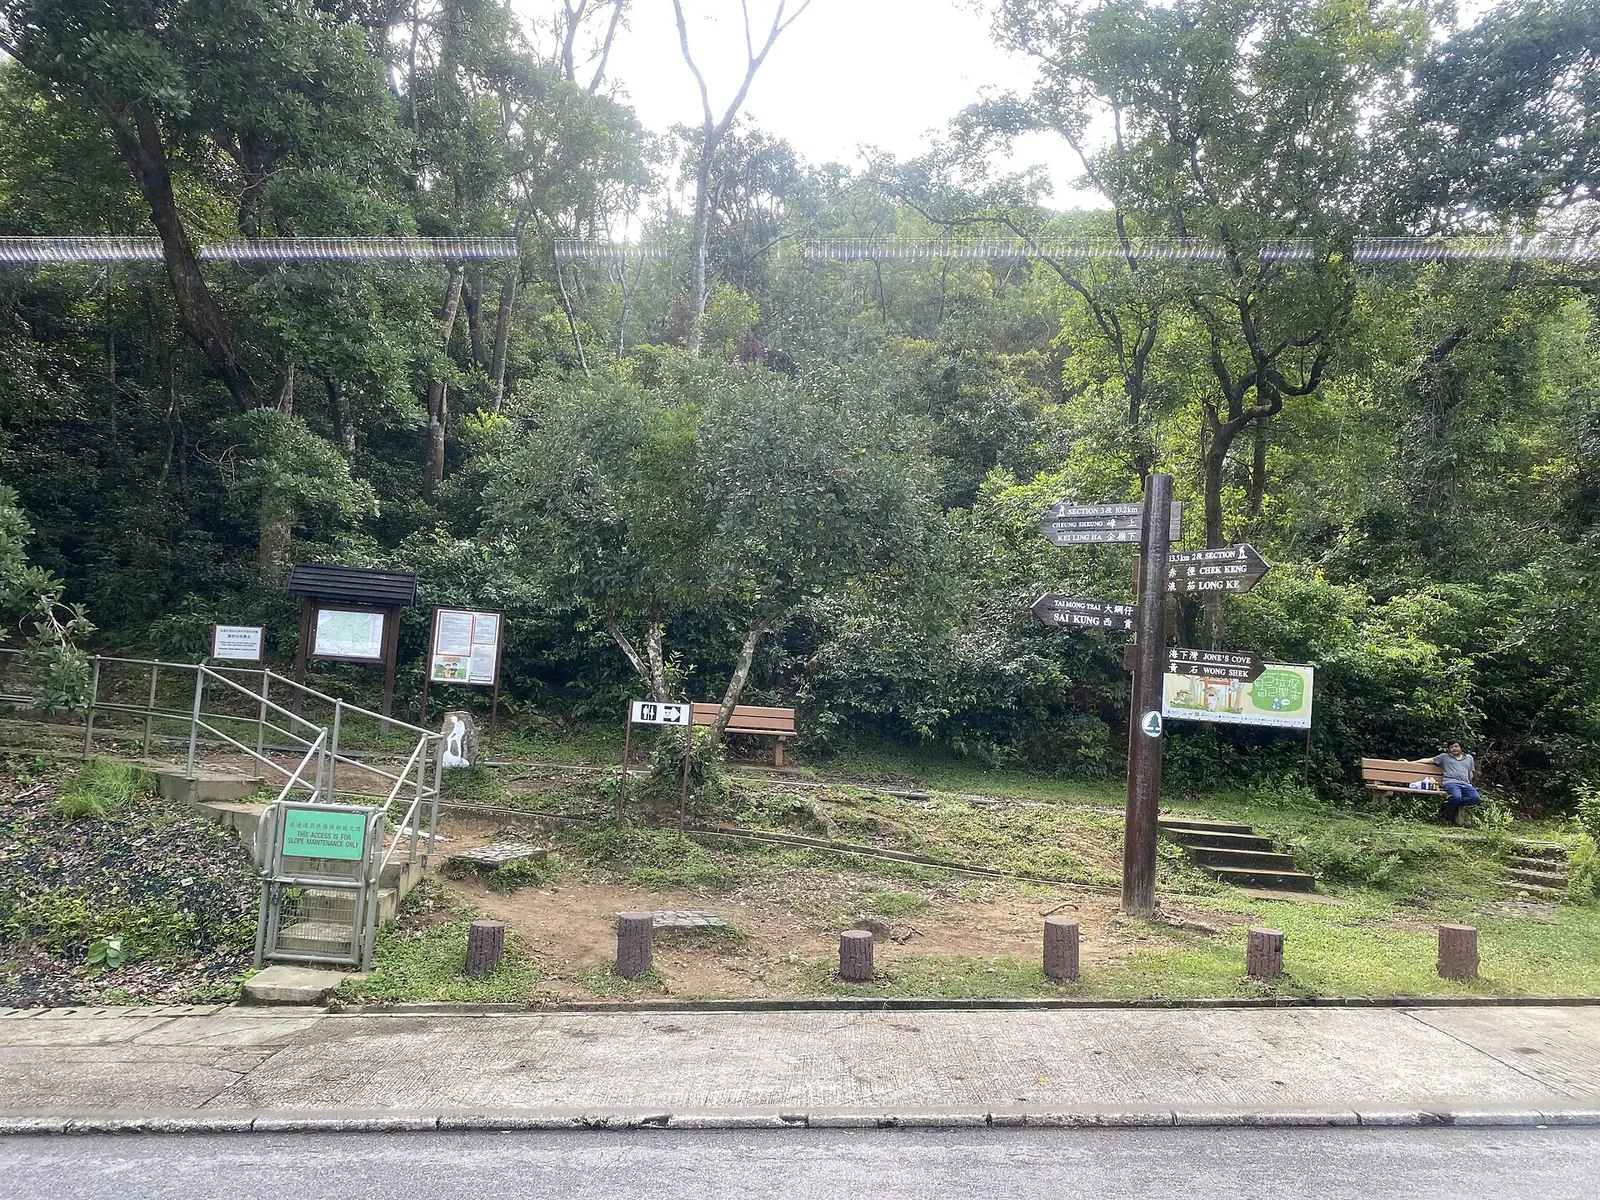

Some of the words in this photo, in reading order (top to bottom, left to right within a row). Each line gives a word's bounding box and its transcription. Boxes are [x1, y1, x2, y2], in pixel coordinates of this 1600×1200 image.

[1205, 551, 1236, 559] SECTION
[1199, 566, 1222, 574] CHEK
[1224, 565, 1247, 573] KENG
[1198, 581, 1223, 590] LONG
[1226, 580, 1239, 588] KE
[1054, 613, 1069, 622] SAI
[1073, 615, 1100, 625] KUNG
[1203, 653, 1229, 662] JONE'S
[1232, 656, 1251, 664] COVE
[1203, 667, 1226, 676] WONG
[307, 839, 343, 847] MAINTENANCE
